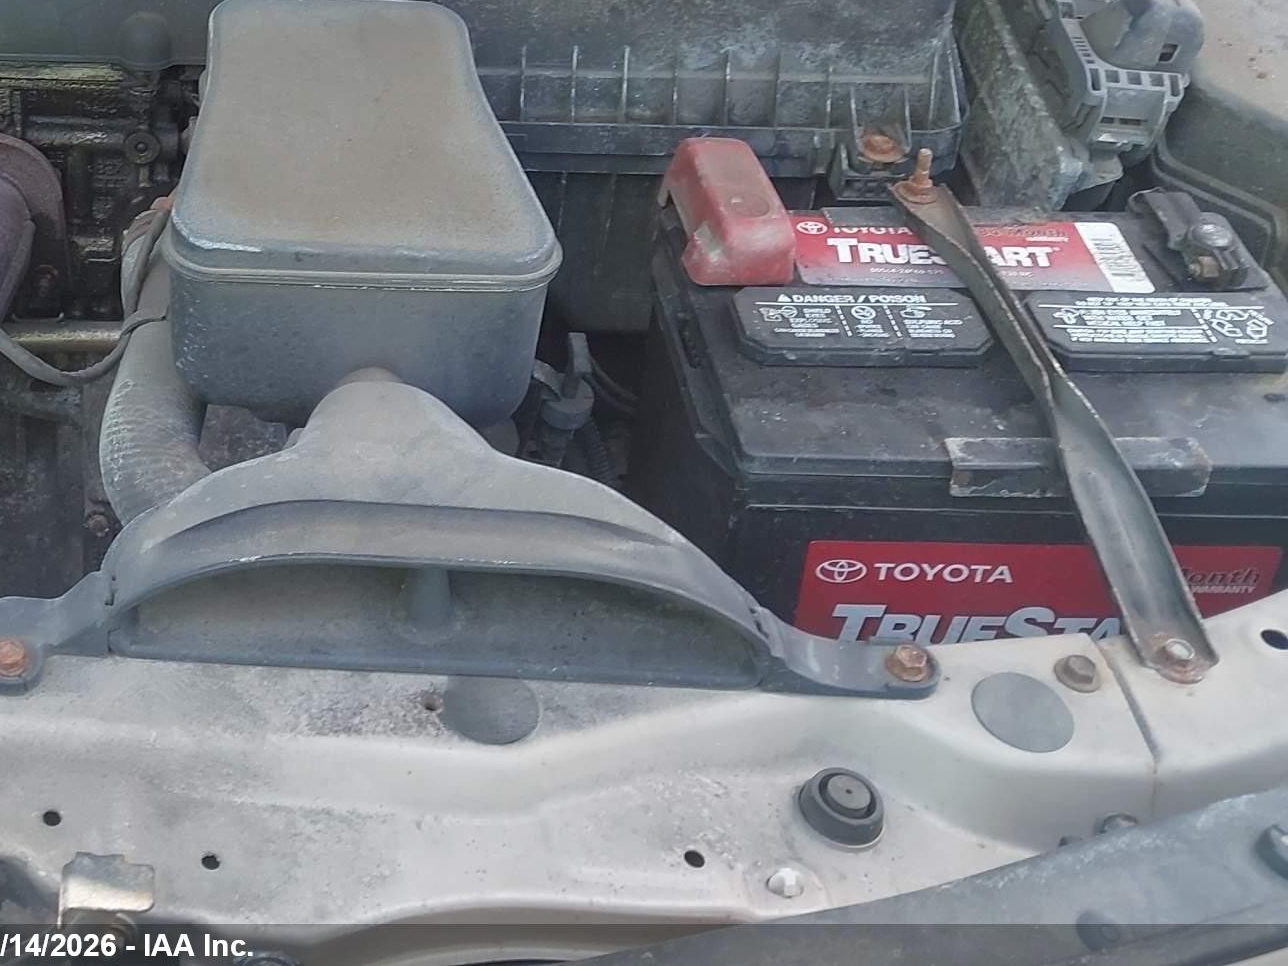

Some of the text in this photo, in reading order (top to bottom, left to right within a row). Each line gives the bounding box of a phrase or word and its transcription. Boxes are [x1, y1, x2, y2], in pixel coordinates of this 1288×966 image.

[792, 294, 855, 303] DANGER
[870, 294, 927, 303] POISON
[874, 562, 1013, 583] TOYOTA
